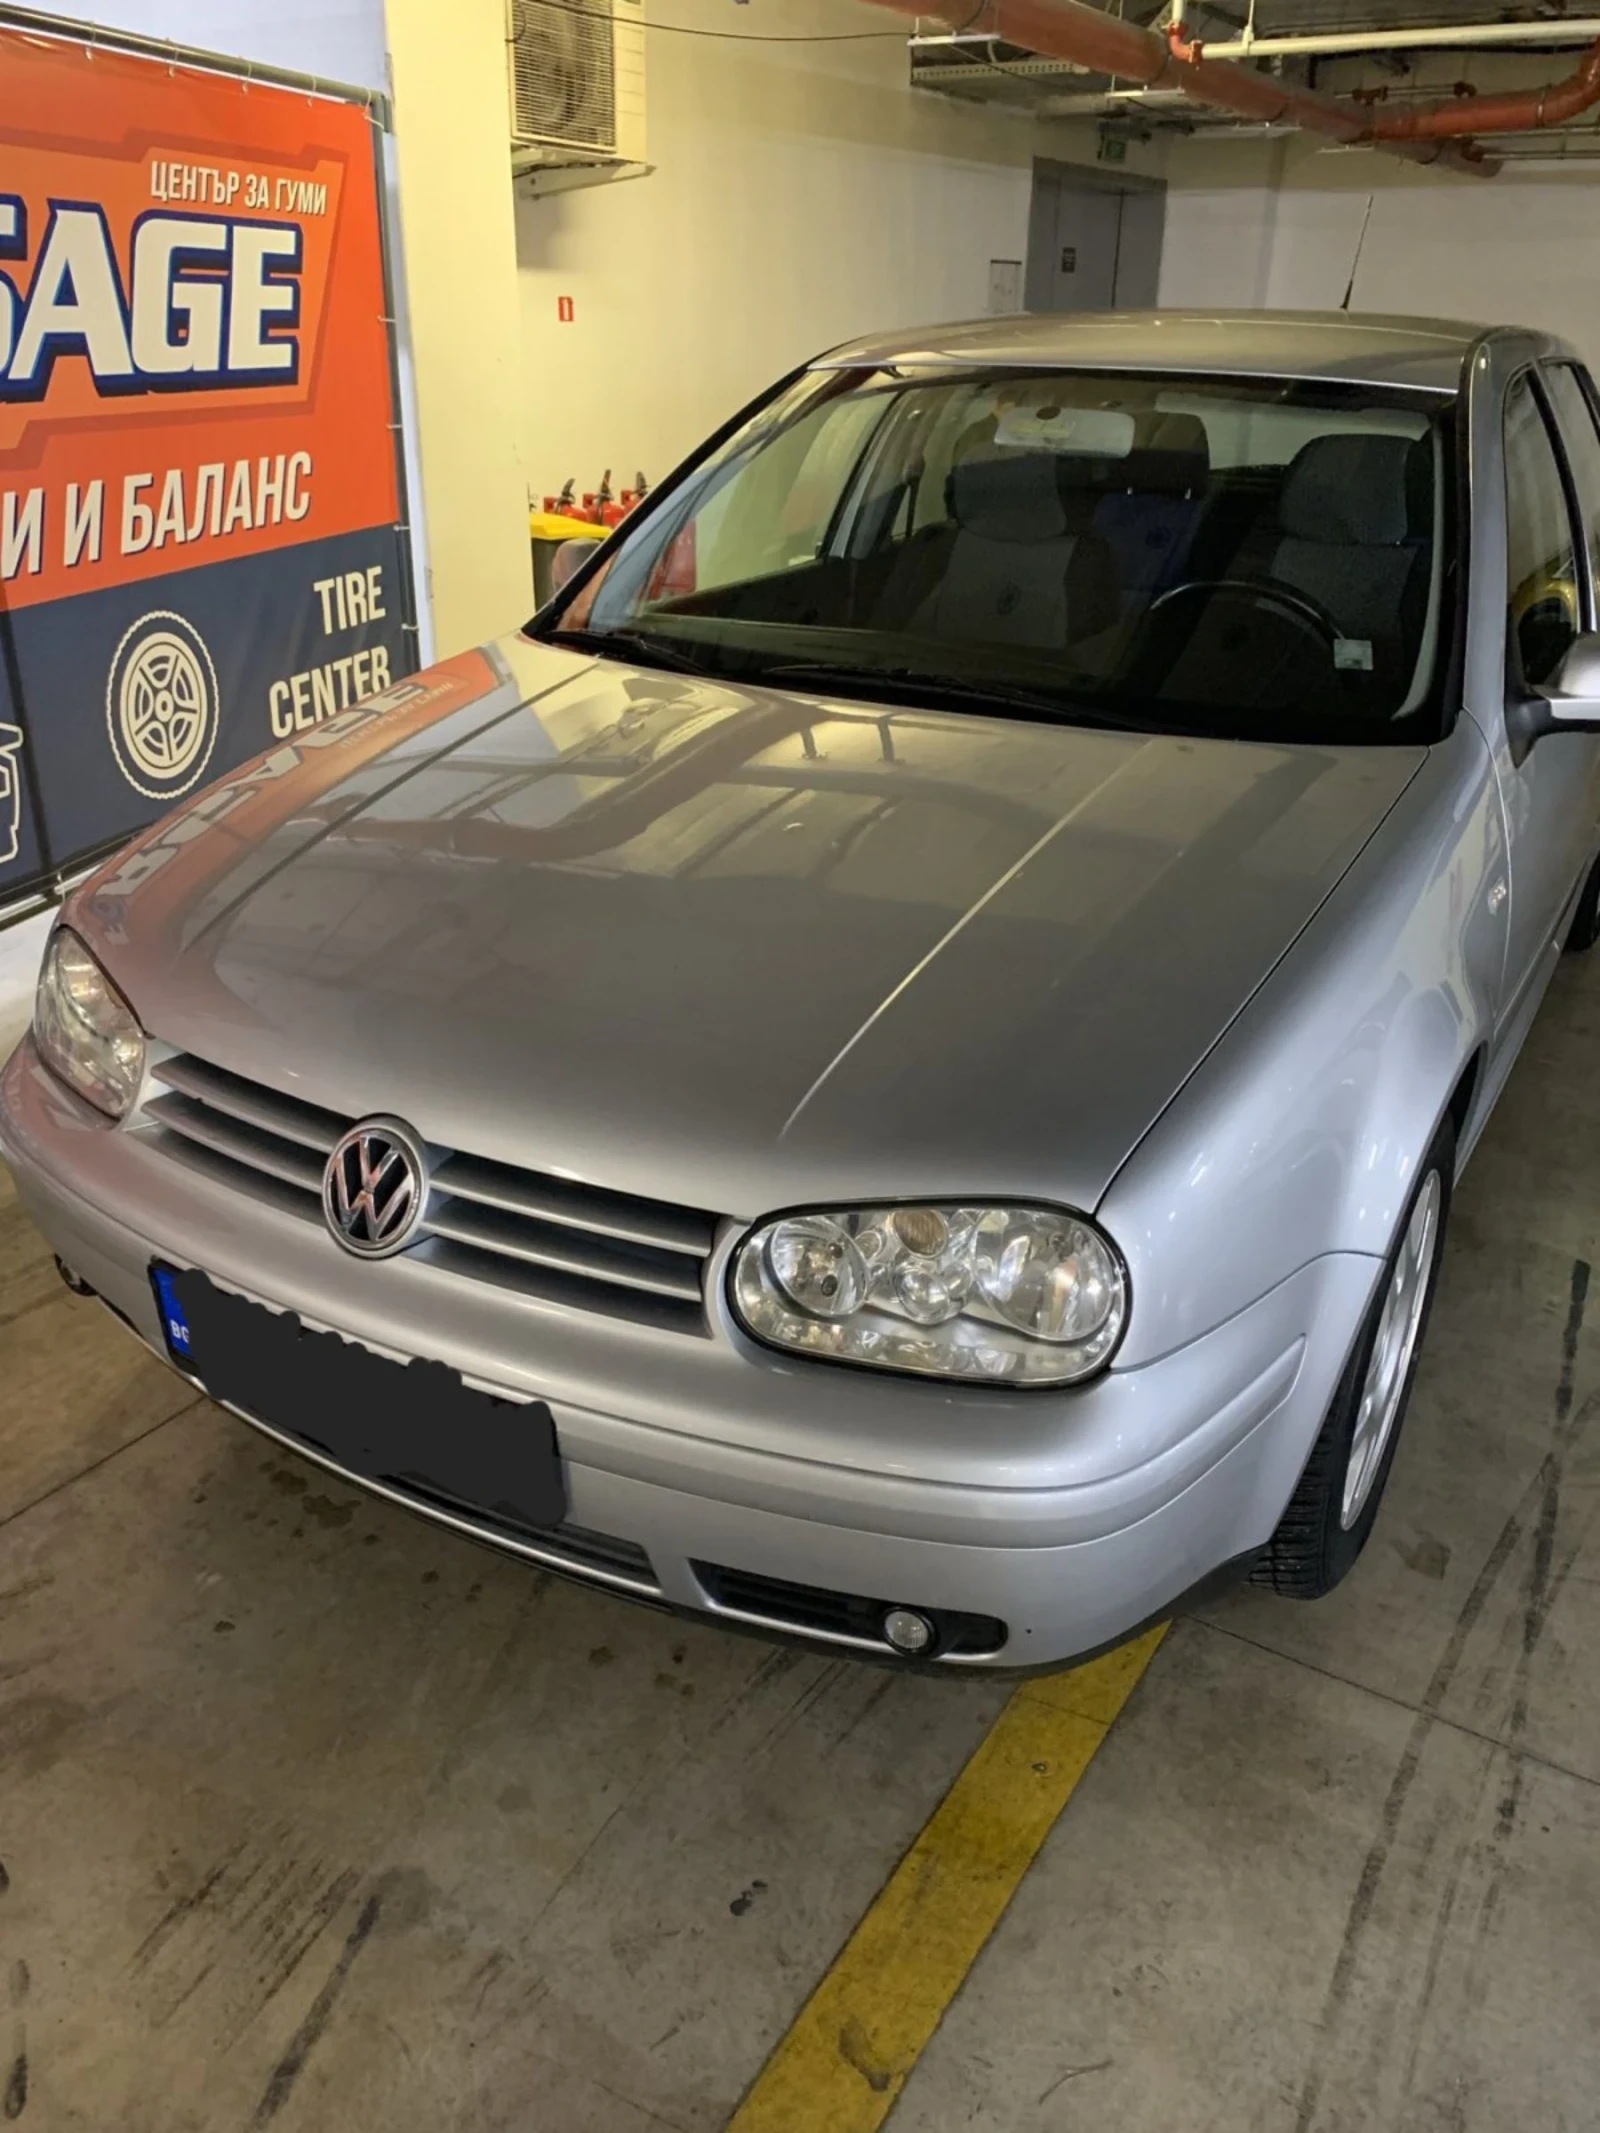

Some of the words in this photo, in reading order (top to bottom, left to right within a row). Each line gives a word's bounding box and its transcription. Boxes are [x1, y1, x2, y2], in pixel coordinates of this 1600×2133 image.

[151, 160, 240, 205] ЦЕНТЪР
[244, 173, 270, 208] ЗА
[275, 178, 327, 215] ГУМИ
[0, 200, 300, 387] AGE
[63, 479, 104, 567] И
[120, 451, 312, 555] БАЛАНС
[313, 565, 386, 635] TIRE
[269, 645, 391, 738] CENTER
